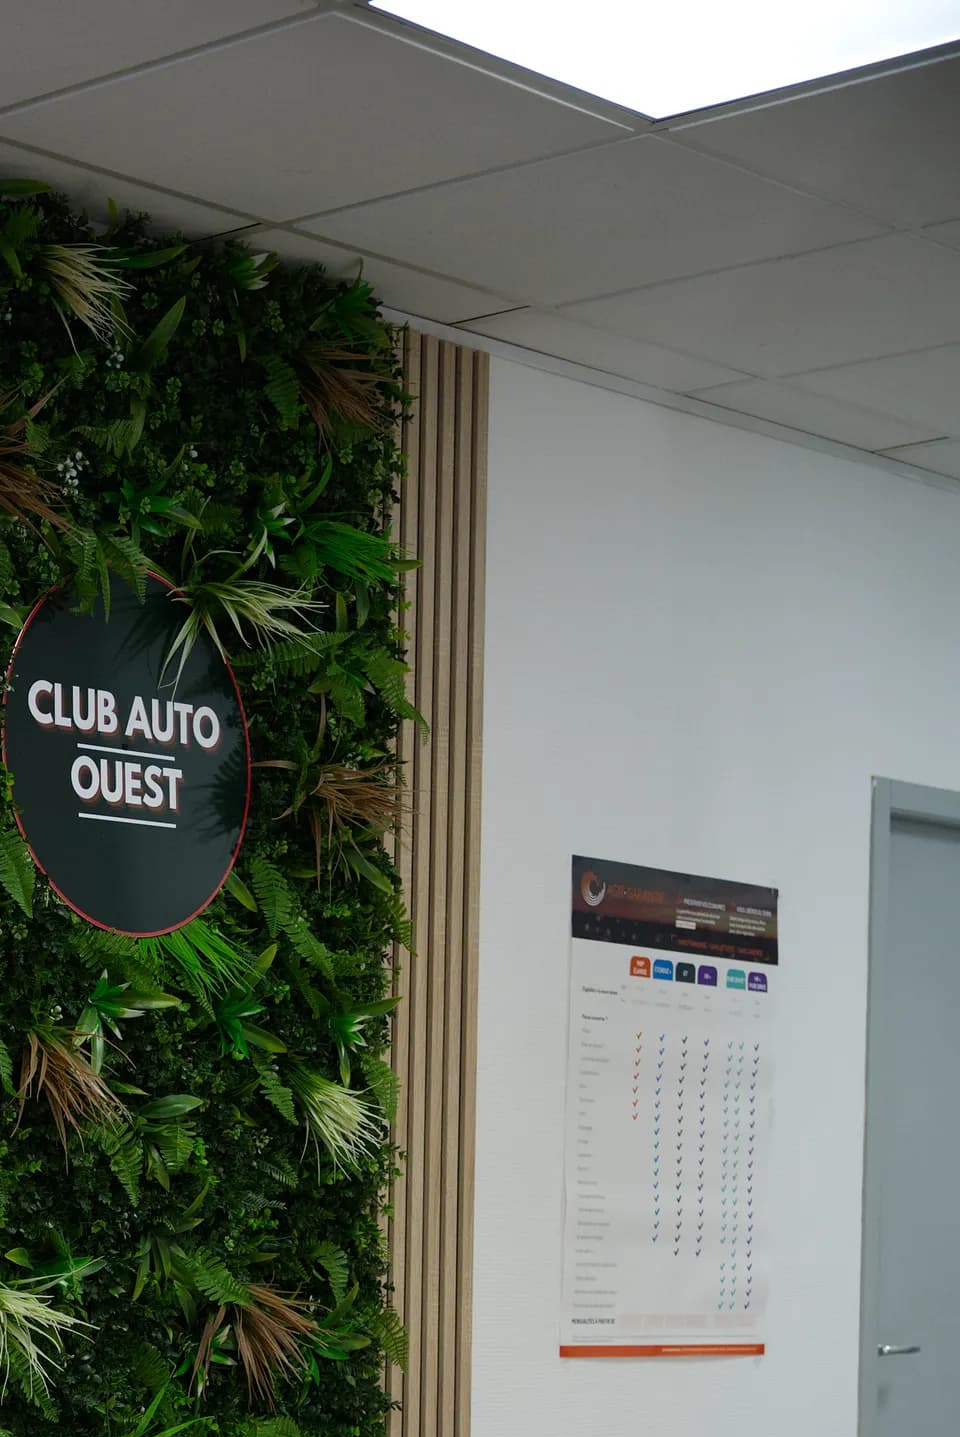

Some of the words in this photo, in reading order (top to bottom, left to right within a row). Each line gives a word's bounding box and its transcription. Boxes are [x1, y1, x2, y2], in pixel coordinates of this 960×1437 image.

[27, 679, 118, 733] CLUB
[124, 695, 220, 748] AUTO
[70, 755, 182, 810] OUEST
